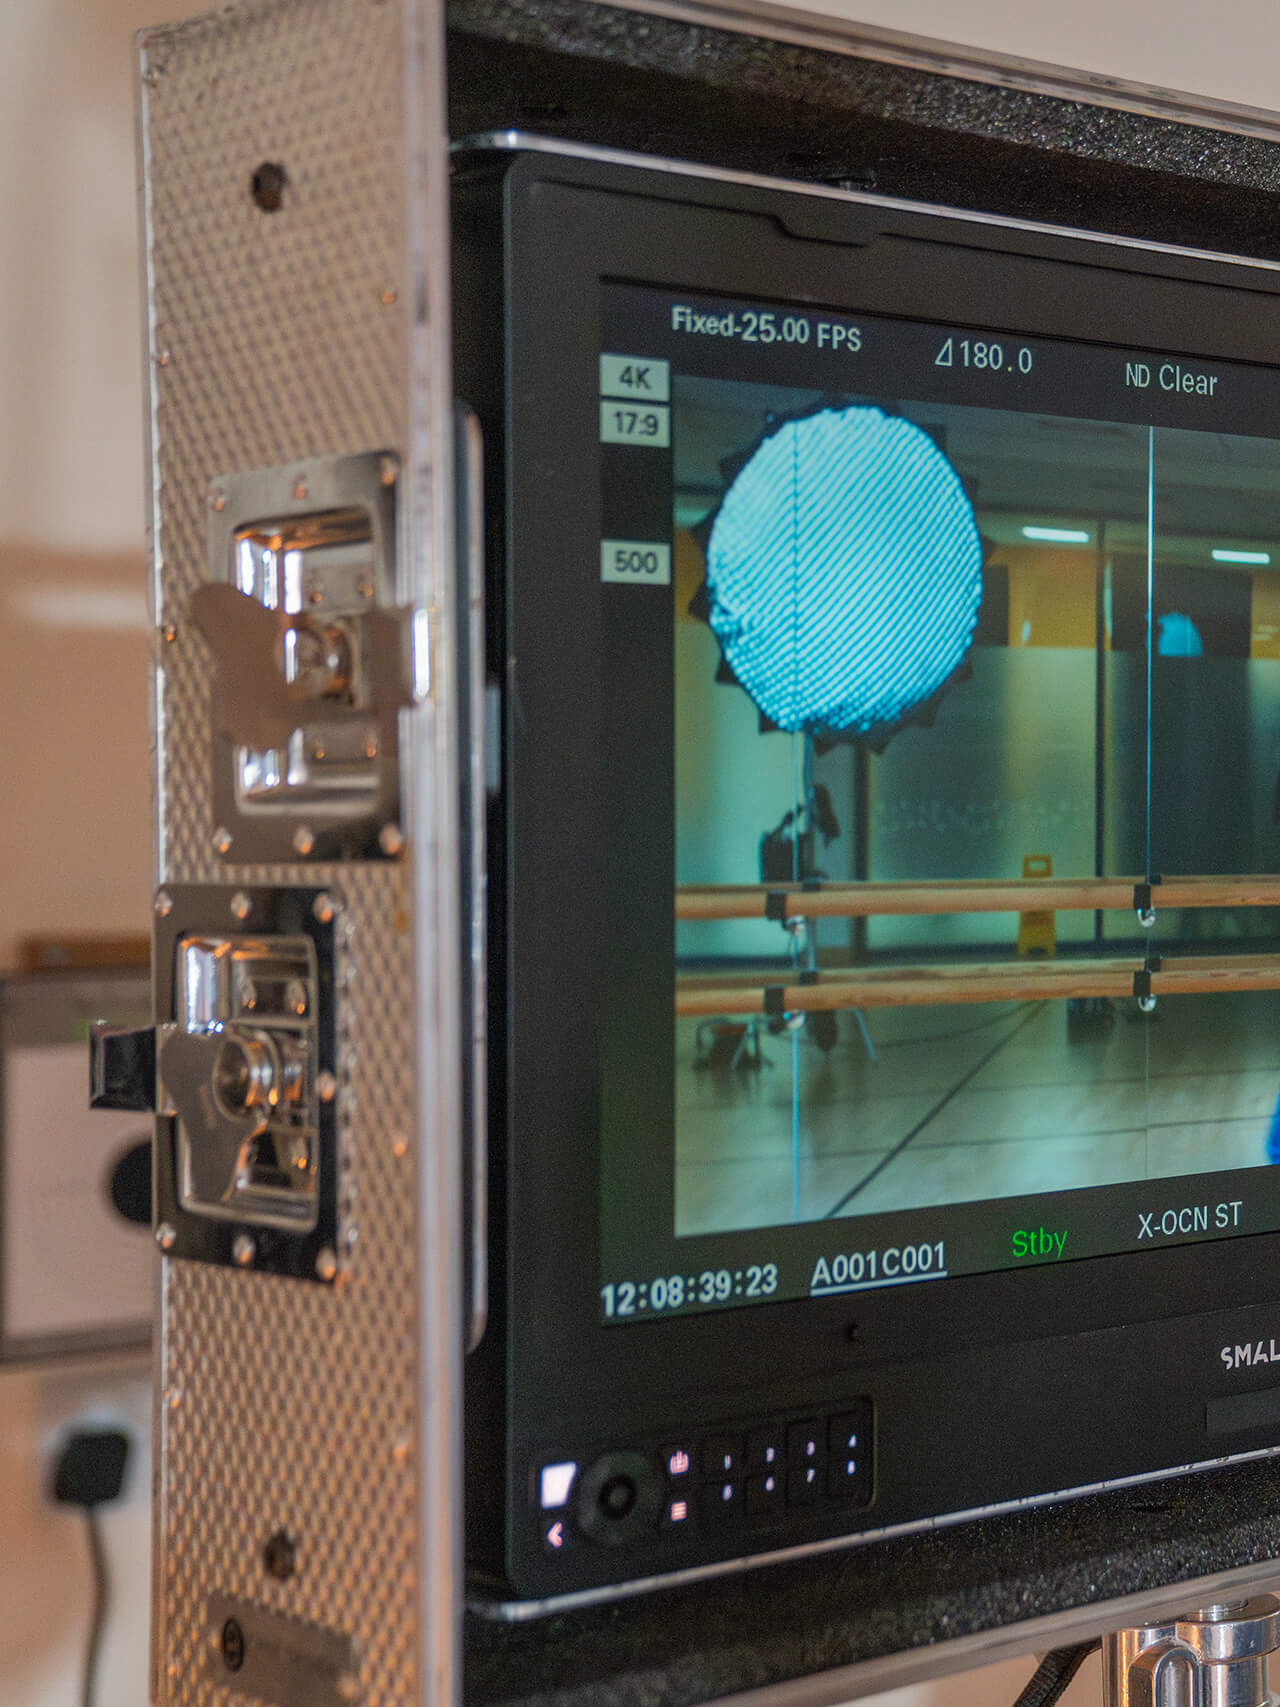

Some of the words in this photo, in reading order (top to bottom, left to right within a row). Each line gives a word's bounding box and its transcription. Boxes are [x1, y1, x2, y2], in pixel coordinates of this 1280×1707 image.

[670, 305, 811, 345] Fixed-25.00
[816, 324, 863, 353] FPS
[618, 363, 652, 390] 4K
[1125, 362, 1151, 388] ND
[1159, 364, 1218, 397] Clear
[614, 410, 660, 438] 17:9
[614, 549, 658, 575] 500
[1137, 1205, 1208, 1239] X-OCN
[1215, 1201, 1243, 1227] ST
[1011, 1227, 1068, 1258] Stby
[811, 1242, 946, 1288] A001C001
[602, 1265, 779, 1316] 12:08:39:23
